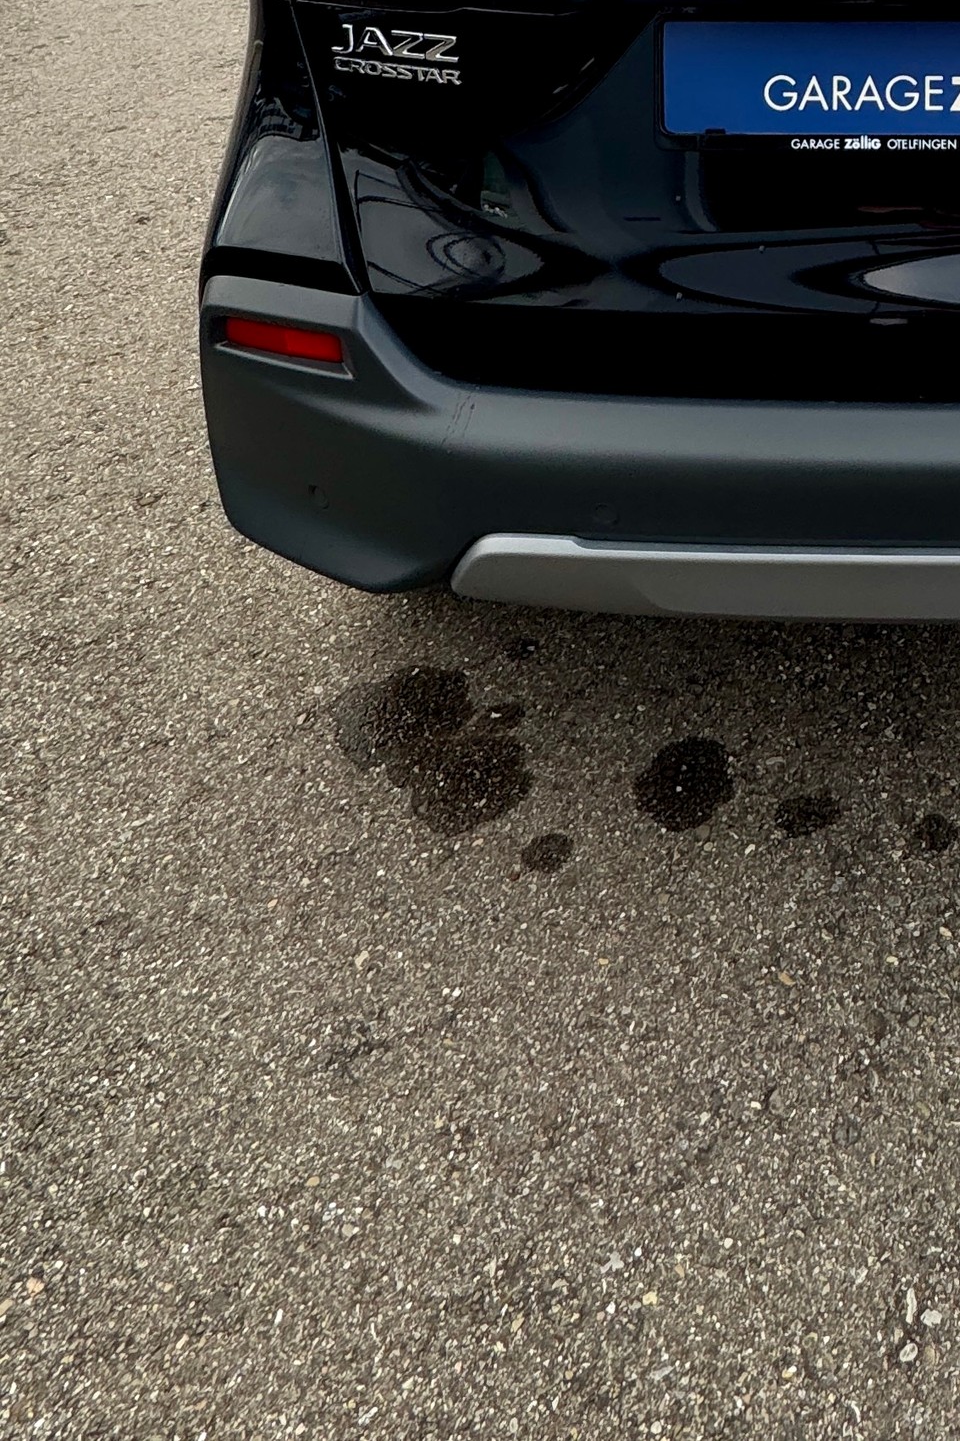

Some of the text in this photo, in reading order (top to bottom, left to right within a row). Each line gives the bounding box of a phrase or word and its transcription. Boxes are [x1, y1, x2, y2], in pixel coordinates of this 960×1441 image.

[331, 24, 459, 62] JAZZ
[333, 56, 462, 85] CROSSTAR
[790, 137, 841, 150] GARAGE
[886, 138, 958, 151] OTELFINGEN
